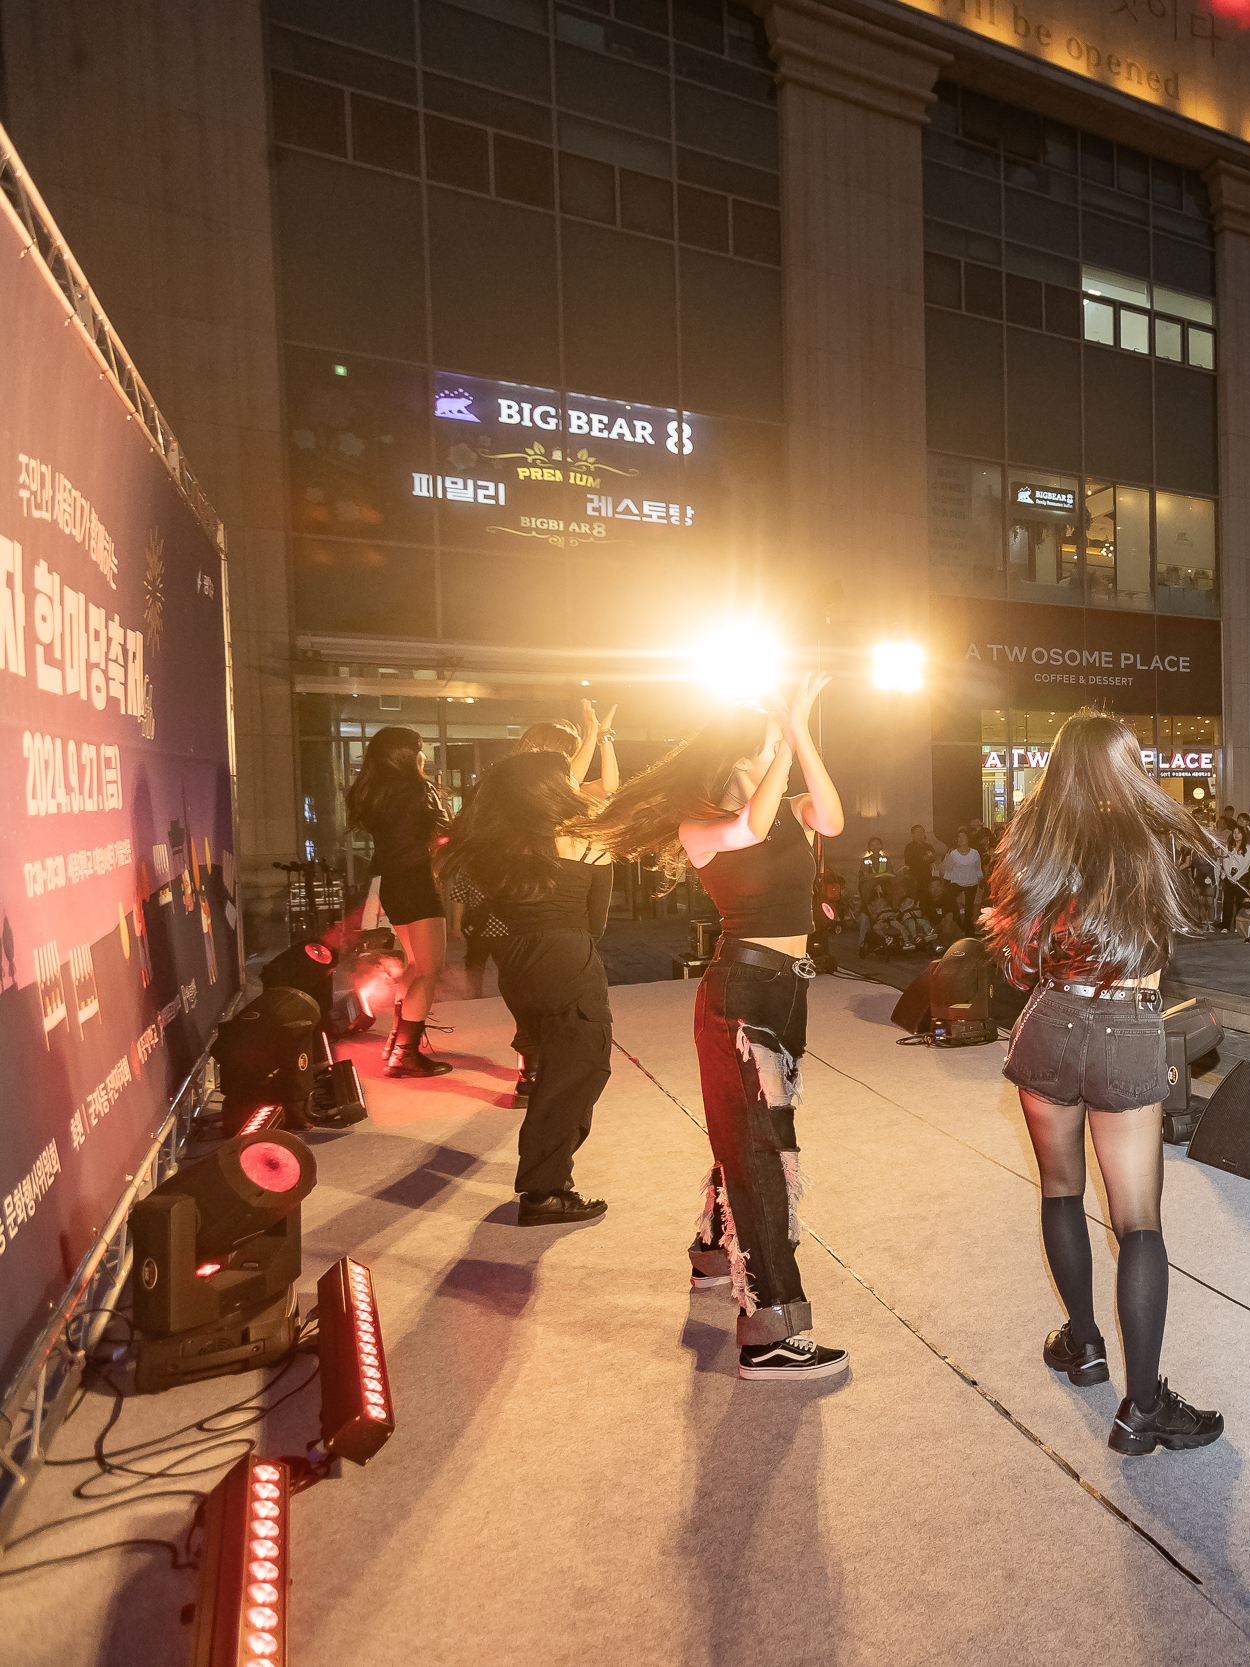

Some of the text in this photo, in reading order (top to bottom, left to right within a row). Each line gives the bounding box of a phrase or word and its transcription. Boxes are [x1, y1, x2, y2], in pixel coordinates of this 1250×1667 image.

[1011, 2, 1052, 48] be
[1064, 32, 1182, 101] opened
[497, 397, 695, 456] BIG BEAR 8
[411, 471, 507, 507] 패밀리
[516, 466, 603, 490] PREMIUM
[18, 453, 53, 522] 주민과
[53, 471, 91, 551] 세종대가
[90, 506, 119, 591] 함께하는
[34, 558, 144, 717] 한마당축제
[964, 643, 1191, 673] A TWOSOME PLACE
[1034, 673, 1134, 687] COFFEE & DESSERT
[983, 750, 1003, 769] A
[1140, 749, 1213, 769] PLACE
